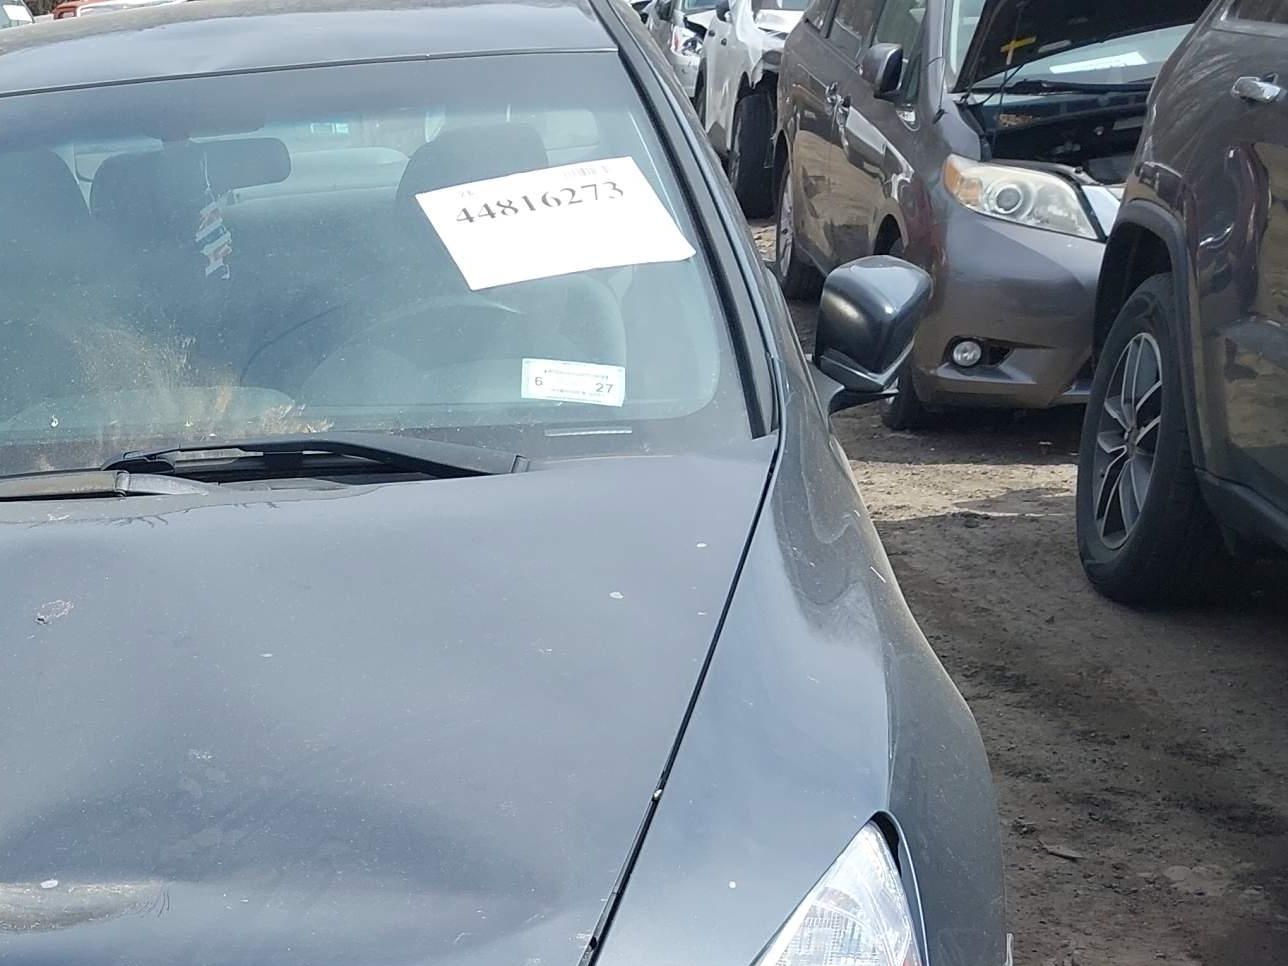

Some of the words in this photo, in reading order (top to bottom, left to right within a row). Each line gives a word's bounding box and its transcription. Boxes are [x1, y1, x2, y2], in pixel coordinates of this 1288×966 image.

[456, 181, 624, 223] 44816273
[534, 376, 544, 387] 6
[595, 383, 614, 394] 27
